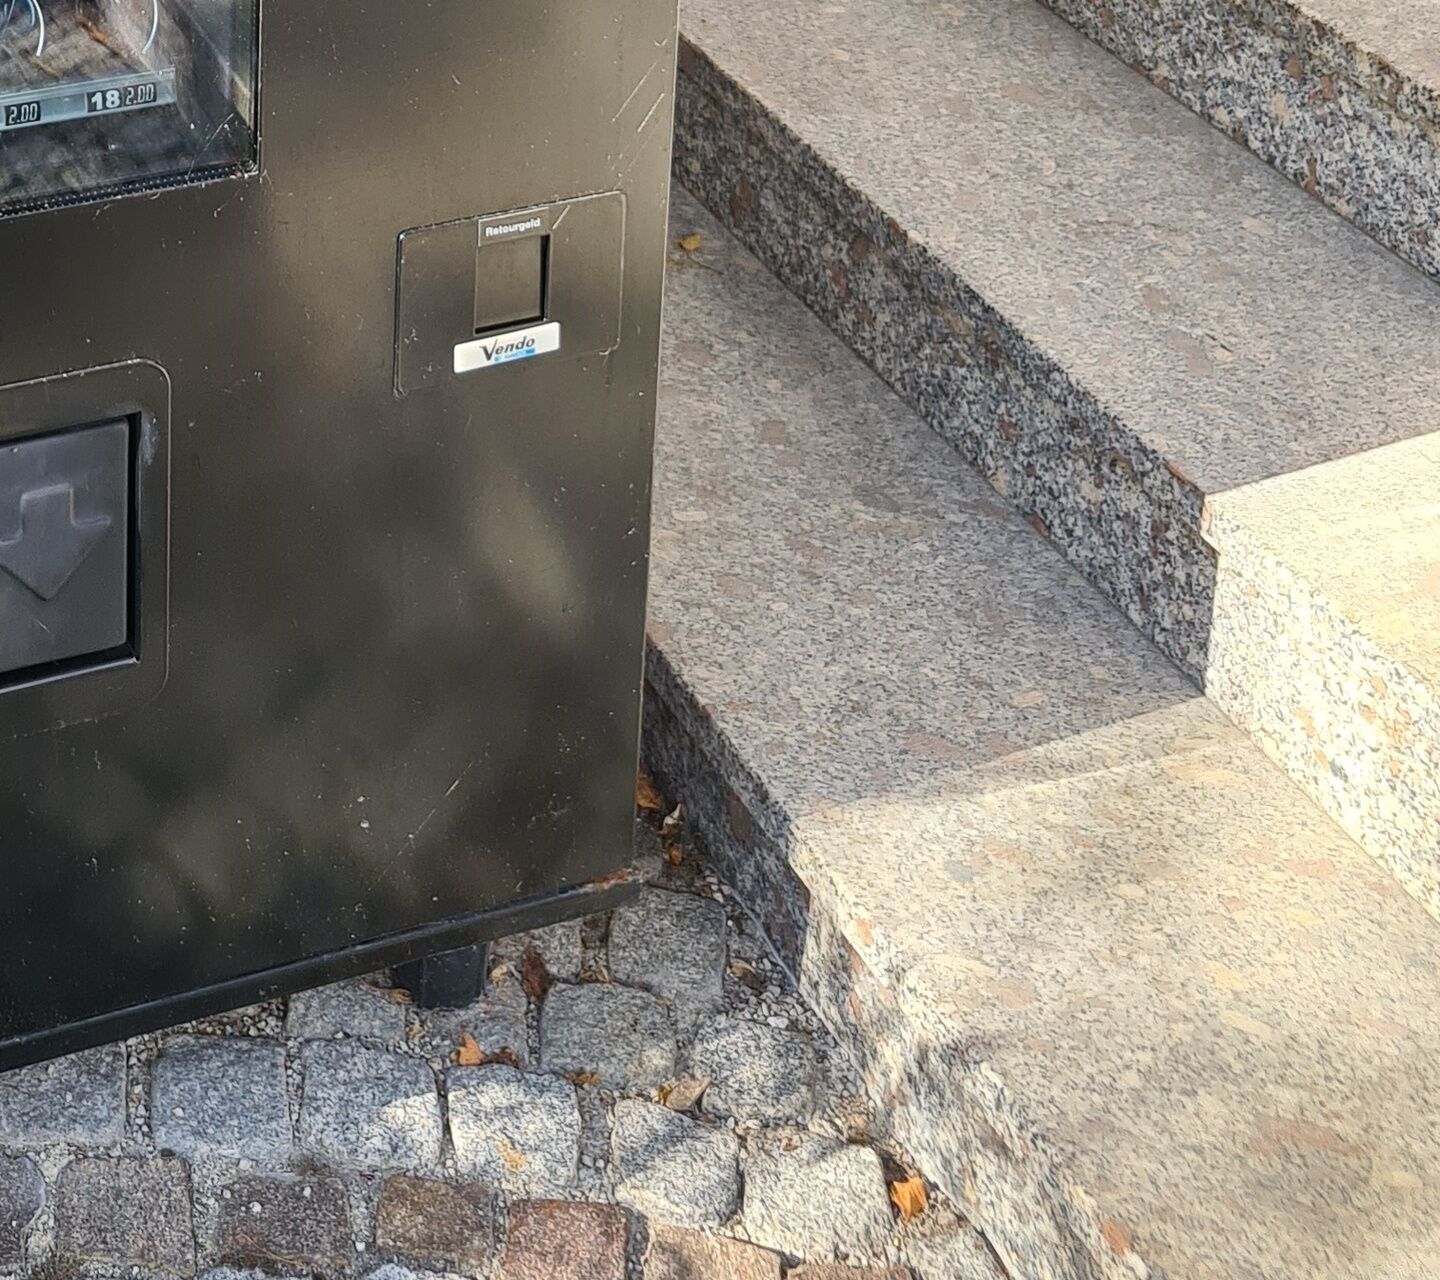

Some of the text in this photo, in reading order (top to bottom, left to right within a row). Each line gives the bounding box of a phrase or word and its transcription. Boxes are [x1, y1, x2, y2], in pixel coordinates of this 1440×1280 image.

[91, 84, 155, 110] 18 2.00
[8, 103, 39, 125] 2.00
[485, 217, 541, 237] Retourgeld
[480, 335, 536, 361] Vendo
